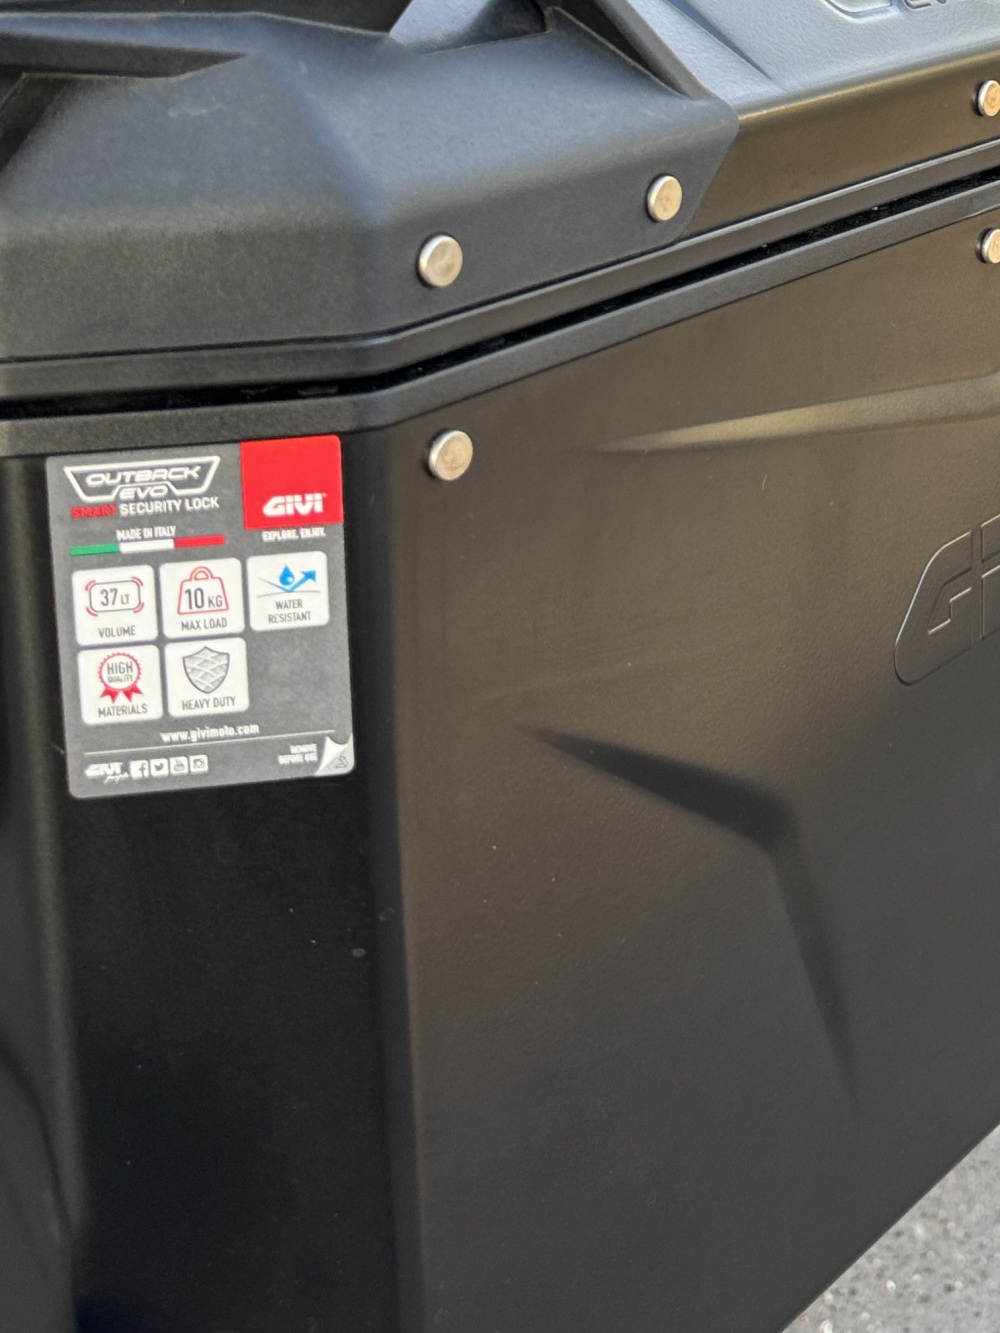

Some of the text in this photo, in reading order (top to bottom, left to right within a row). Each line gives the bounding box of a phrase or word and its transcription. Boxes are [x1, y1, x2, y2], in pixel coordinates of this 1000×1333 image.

[85, 465, 201, 487] OUTBACK
[119, 485, 168, 500] EVO
[70, 496, 219, 519] SMART SECURITY LOCK
[263, 493, 323, 517] GIVI
[116, 525, 177, 540] MADE IN ITALY
[100, 588, 130, 606] 37 LT
[185, 588, 223, 609] 10 KG
[275, 599, 303, 610] WATER
[181, 617, 227, 631] MAX LOAD
[268, 611, 312, 624] RESISTANT
[98, 625, 136, 638] VOLUME
[107, 662, 133, 675] HIGH
[108, 674, 133, 684] QUALITY
[98, 703, 148, 717] MATERIALS
[182, 696, 236, 710] HEAVY DUTY
[160, 724, 260, 742] www.givimoto.com
